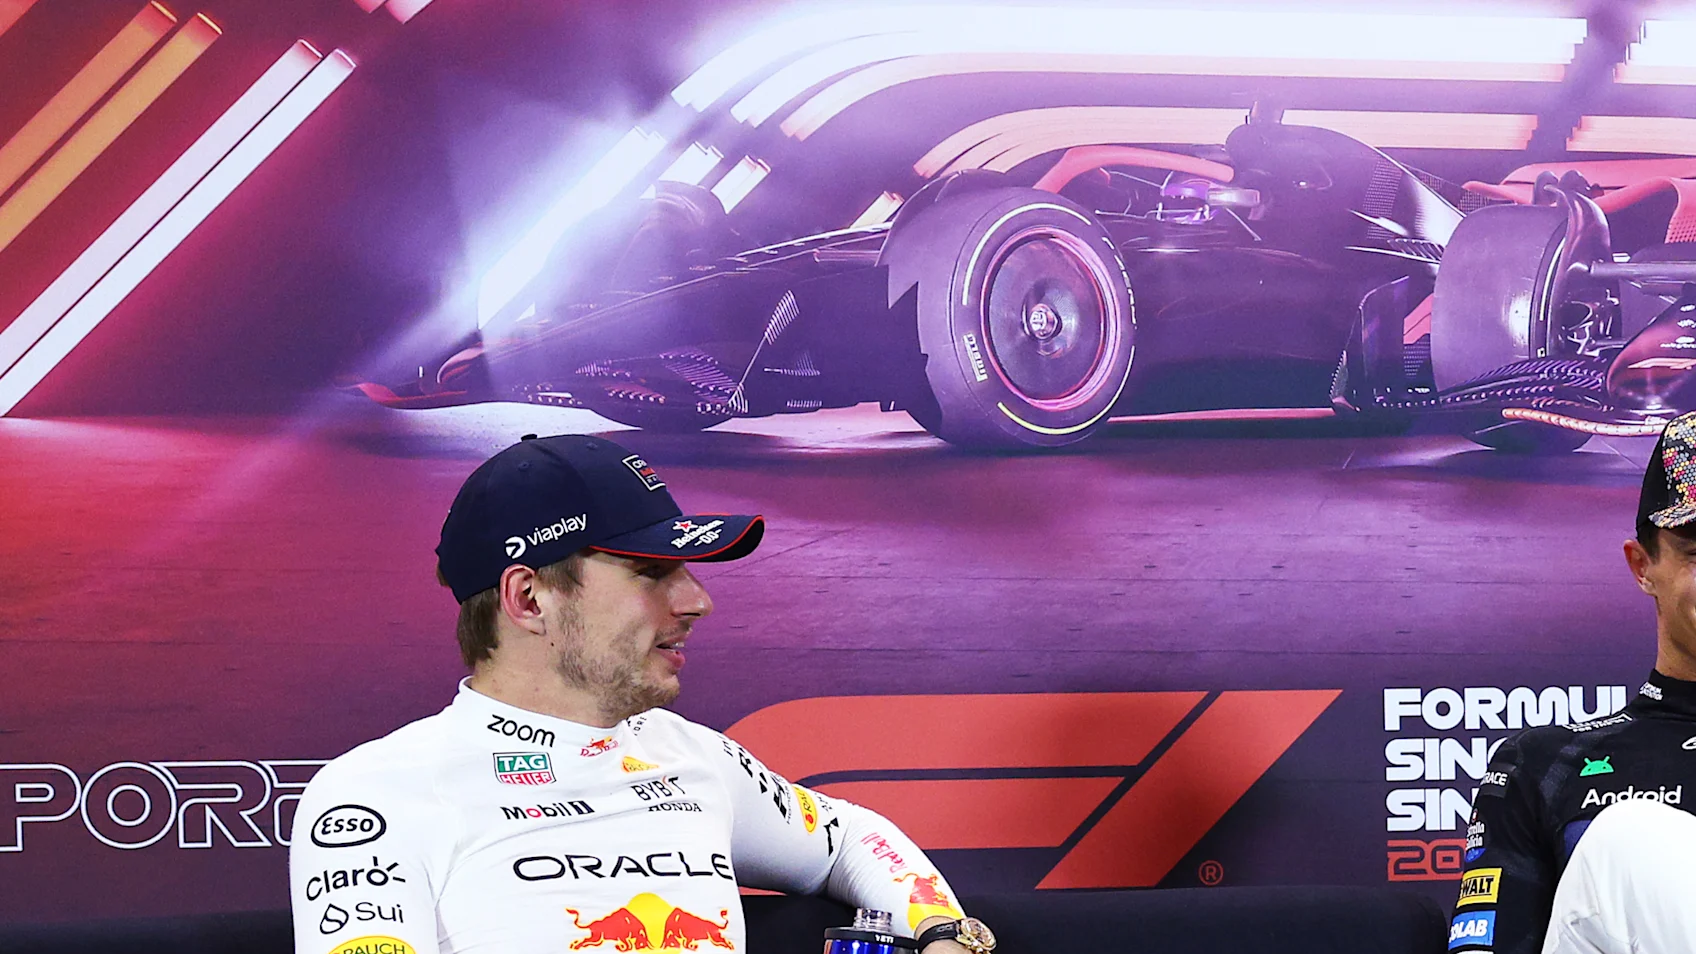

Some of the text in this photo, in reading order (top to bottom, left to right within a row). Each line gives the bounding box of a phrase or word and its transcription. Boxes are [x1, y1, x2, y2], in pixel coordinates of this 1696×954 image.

[526, 513, 588, 547] viaplay
[487, 714, 556, 748] zoom
[499, 756, 546, 770] TAG
[1384, 737, 1509, 782] SIN
[631, 776, 686, 801] BYBIT
[1580, 785, 1683, 809] Android
[500, 804, 572, 820] Mobil
[513, 851, 734, 881] ORACLE
[306, 863, 392, 901] Claro
[355, 902, 404, 923] Sui
[875, 934, 894, 944] YETI
[1448, 920, 1488, 942] OLAB
